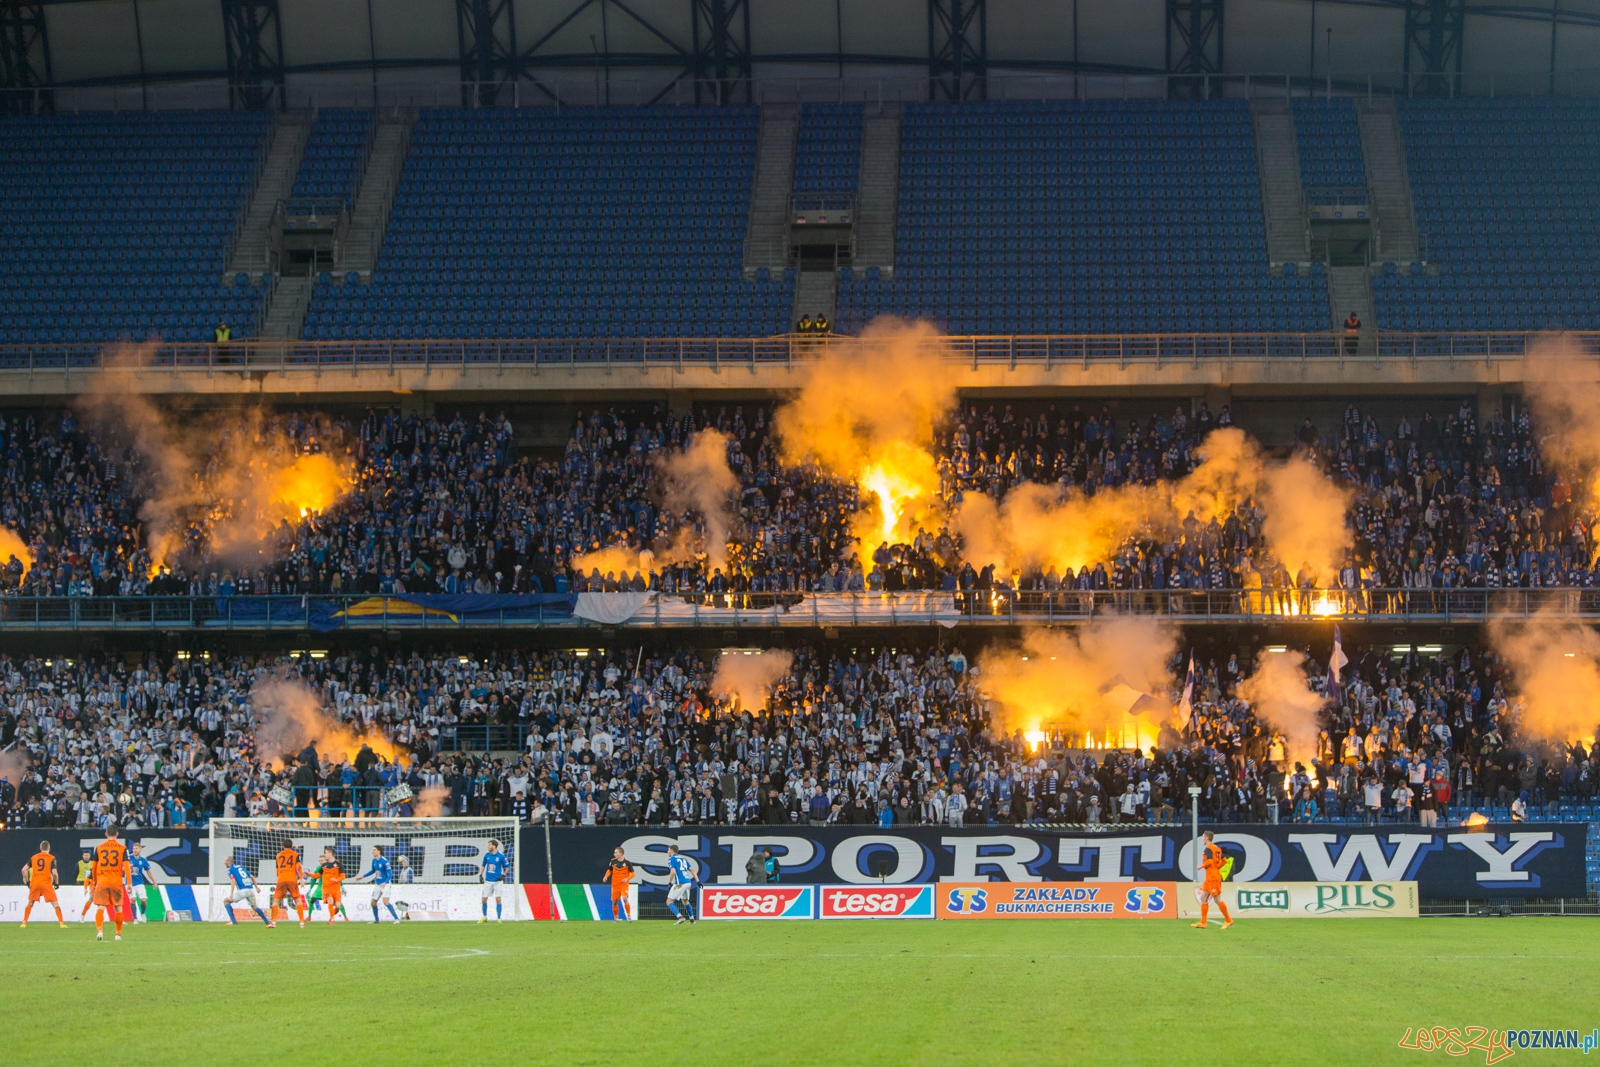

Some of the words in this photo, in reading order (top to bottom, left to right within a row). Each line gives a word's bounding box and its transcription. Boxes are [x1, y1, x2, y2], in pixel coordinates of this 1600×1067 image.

[36, 858, 46, 872] 9
[80, 836, 508, 885] KLUB
[618, 832, 1554, 885] SPORTOWY
[100, 849, 120, 867] 33
[278, 855, 295, 868] 24
[238, 867, 248, 879] 6
[947, 887, 988, 915] STS
[1013, 888, 1100, 901] ZAKŁADY
[1124, 886, 1166, 914] STS
[1240, 891, 1286, 907] LECH
[1313, 883, 1396, 911] PILS
[996, 903, 1114, 914] BUKMACHERSKIE
